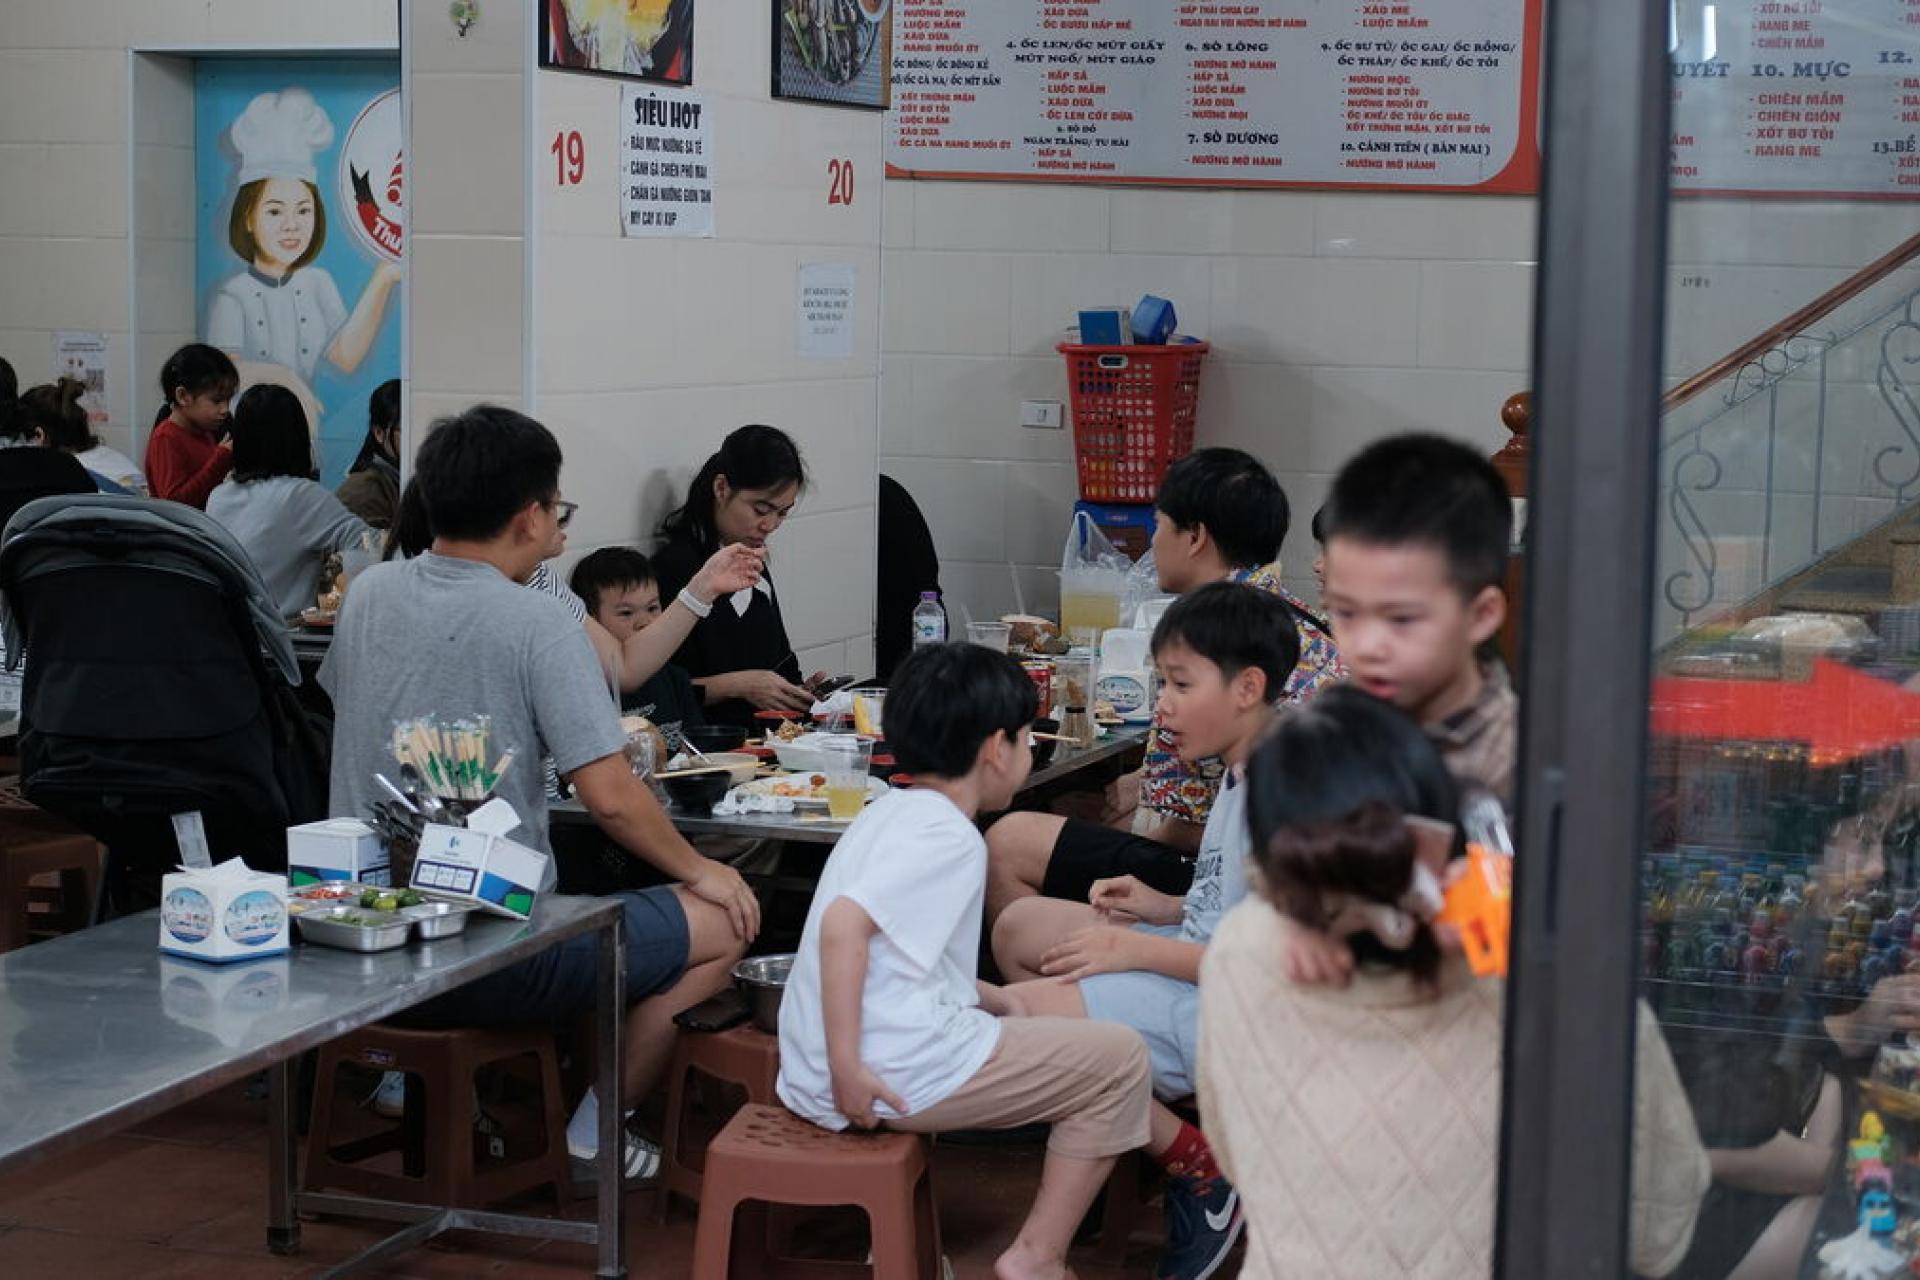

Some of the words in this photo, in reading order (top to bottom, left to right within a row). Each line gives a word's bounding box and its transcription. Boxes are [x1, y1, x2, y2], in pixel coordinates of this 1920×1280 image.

[1751, 63, 1784, 77] 10.
[1793, 60, 1851, 81] MỰC
[635, 91, 668, 128] SIÊU
[671, 101, 702, 131] HOT
[1758, 92, 1801, 105] CHIÊN
[551, 130, 585, 186] 19
[1755, 145, 1794, 157] RANG
[1799, 145, 1822, 157] ME
[827, 158, 854, 206] 20
